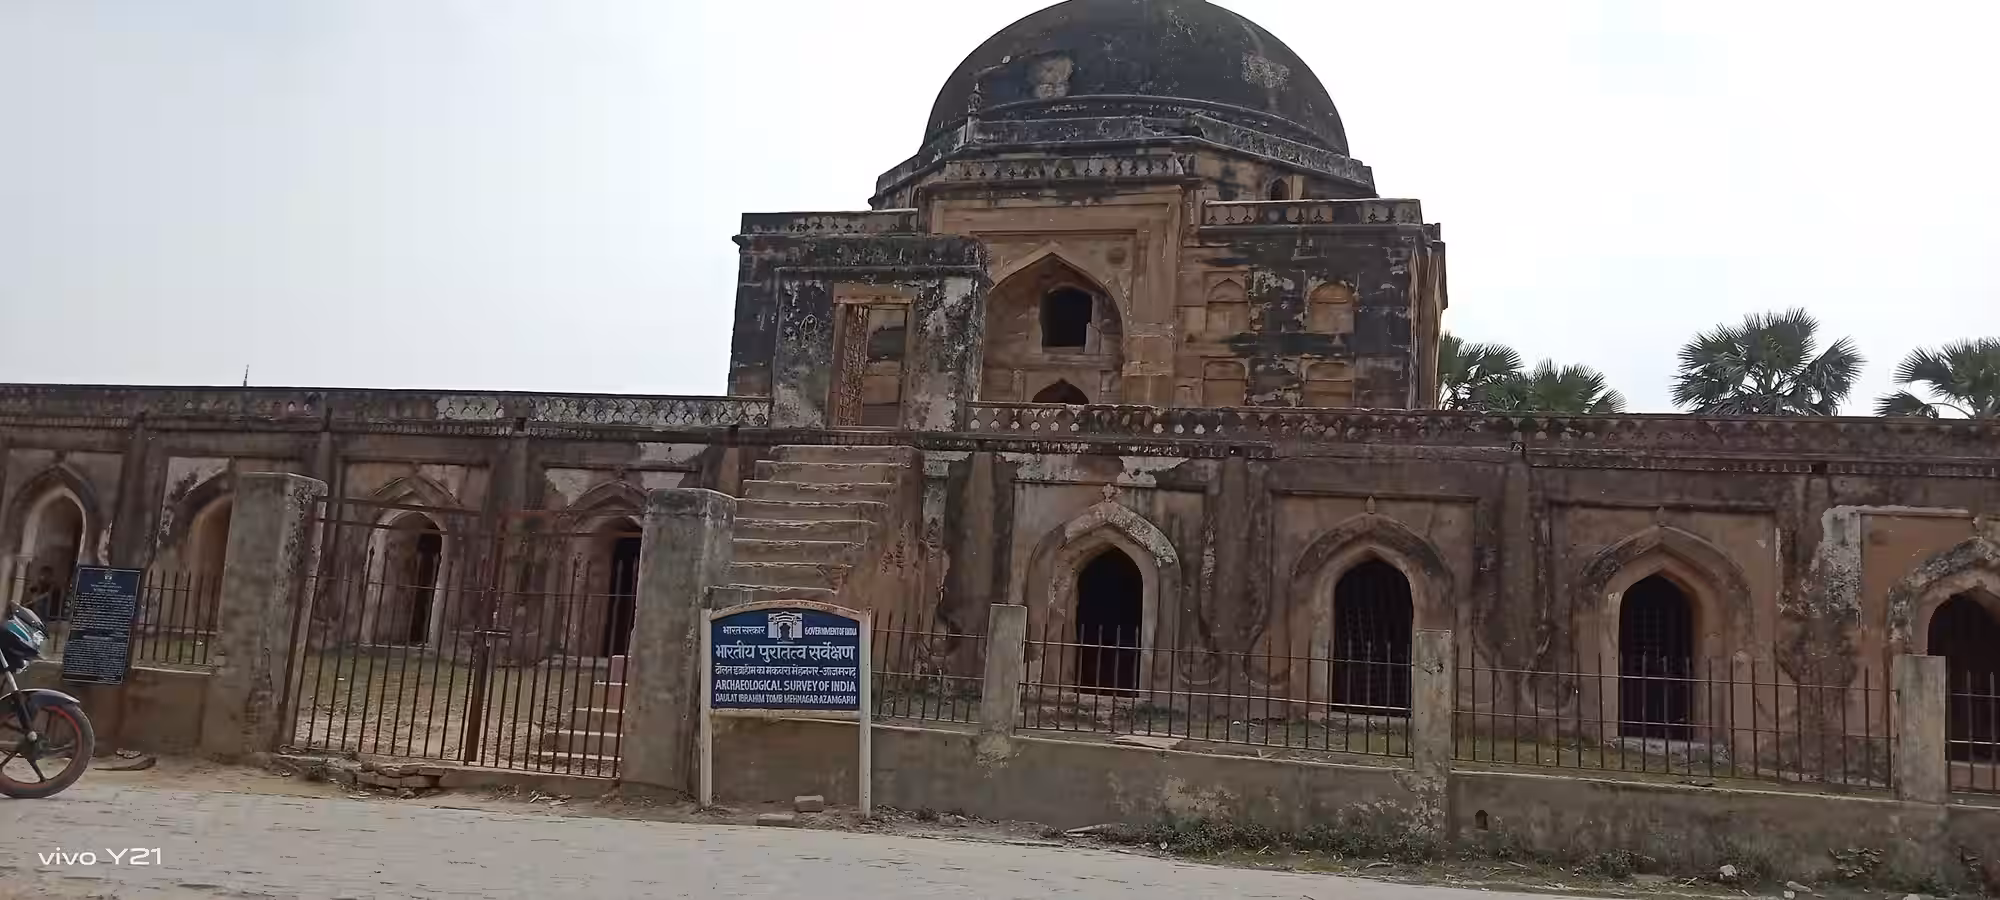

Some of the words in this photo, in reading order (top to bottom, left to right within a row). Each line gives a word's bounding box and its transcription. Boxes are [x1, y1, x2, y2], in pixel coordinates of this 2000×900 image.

[723, 626, 741, 635] भारत
[742, 626, 765, 635] सरकार
[805, 626, 839, 635] GOVERNMENT
[845, 627, 857, 636] INDIA
[715, 640, 756, 659] भारतीय
[758, 645, 807, 663] पुरातत्व
[809, 641, 856, 660] सर्वेक्षण
[715, 680, 782, 691] ARCHAEOLOGICAL
[784, 680, 818, 692] SURVEY
[818, 681, 829, 691] OF
[831, 681, 856, 692] INDIA
[715, 693, 738, 702] DAULAT
[739, 694, 765, 703] IBRAHIM
[766, 694, 783, 703] TOMB
